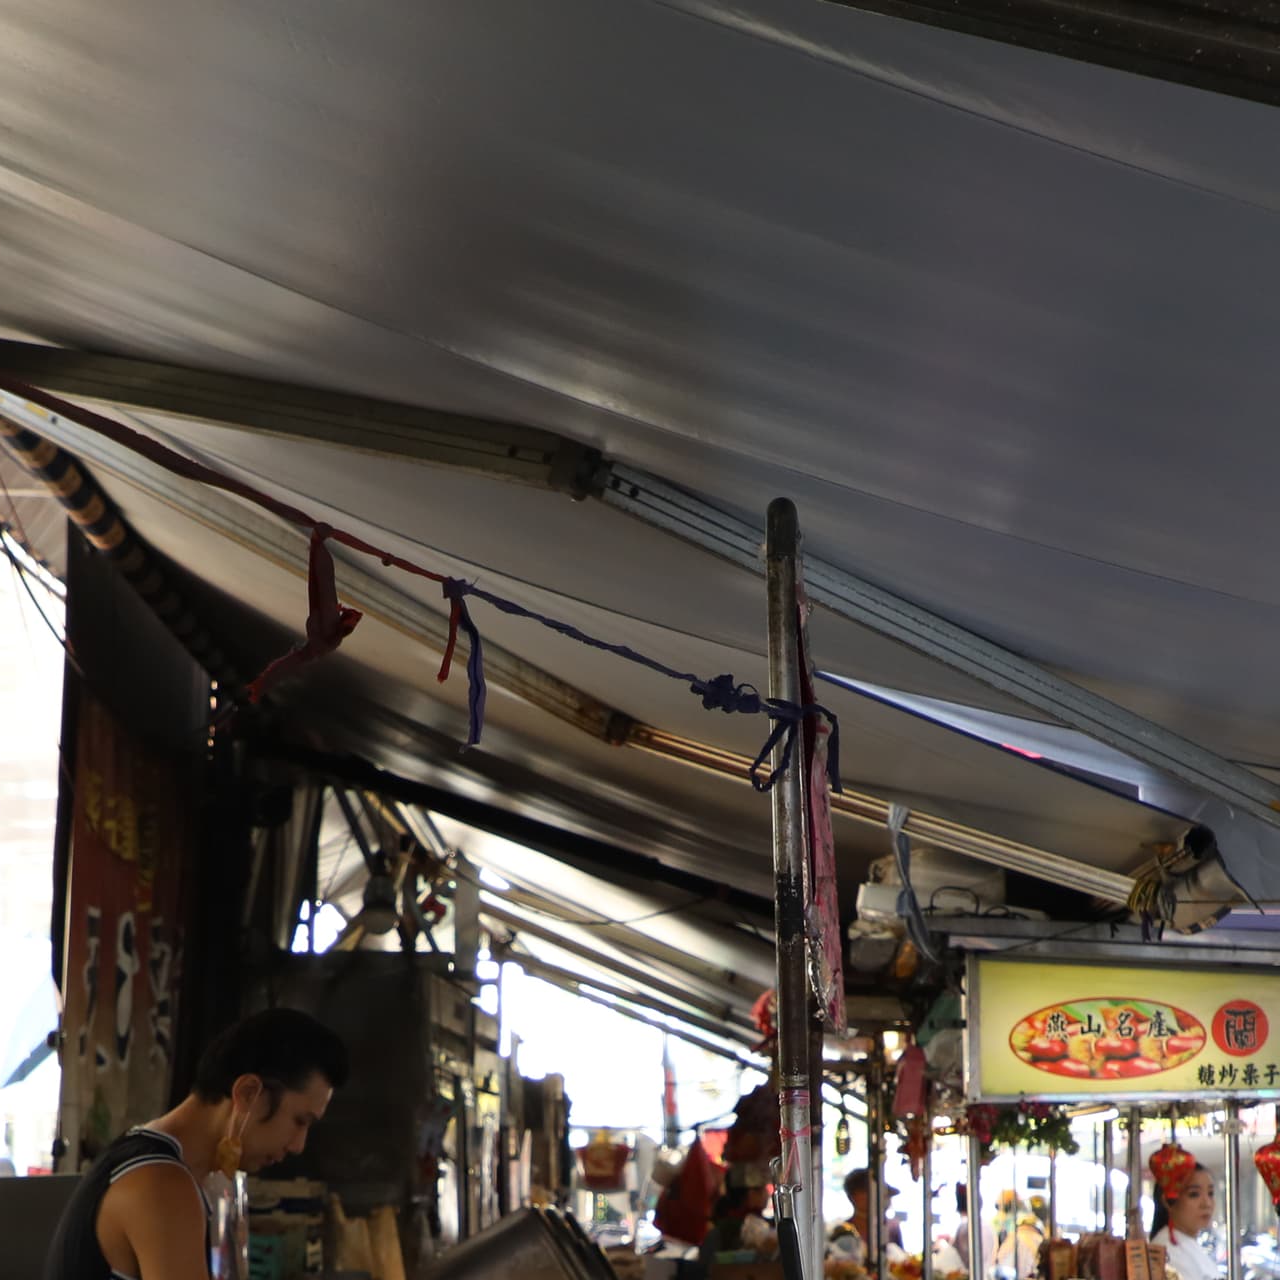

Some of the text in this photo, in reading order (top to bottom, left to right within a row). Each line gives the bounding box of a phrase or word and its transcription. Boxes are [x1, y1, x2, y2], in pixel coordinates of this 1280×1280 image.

[1046, 1010, 1170, 1040] 燕山名產
[1198, 1062, 1280, 1086] 糖炒栗子
